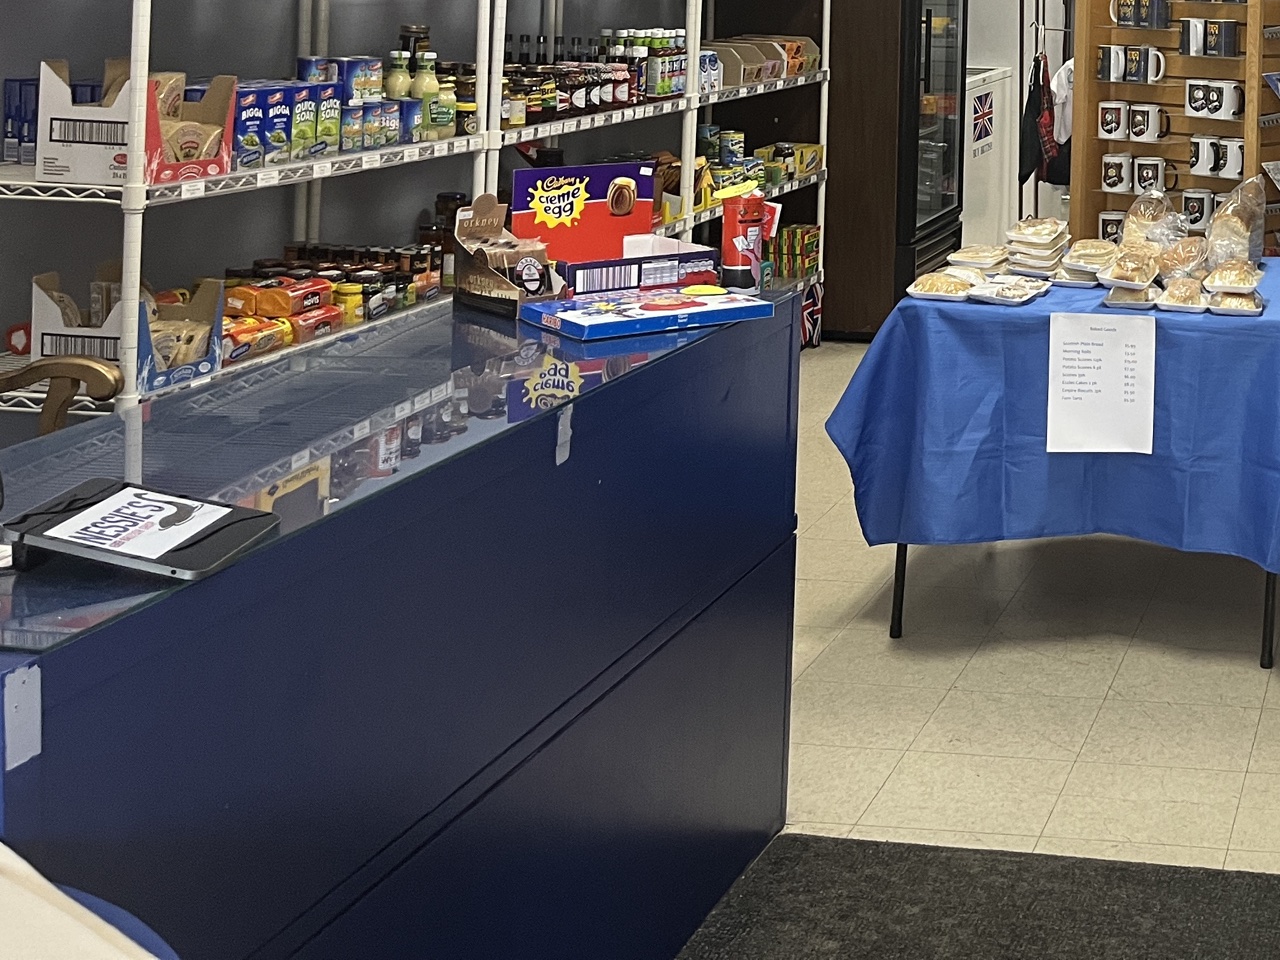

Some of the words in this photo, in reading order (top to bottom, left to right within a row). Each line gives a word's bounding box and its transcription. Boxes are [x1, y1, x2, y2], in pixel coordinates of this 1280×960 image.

[268, 104, 290, 118] BIGGA
[295, 100, 316, 114] QUICK
[320, 98, 340, 110] QUICK
[242, 108, 263, 120] BIGGA
[296, 110, 314, 124] SOAK
[321, 110, 339, 120] SOAK
[538, 187, 580, 204] creme
[544, 200, 574, 219] egg
[464, 218, 499, 228] orkney
[304, 296, 320, 306] HOVIS
[542, 313, 562, 330] HARIBO
[68, 501, 165, 545] NESSIE'S
